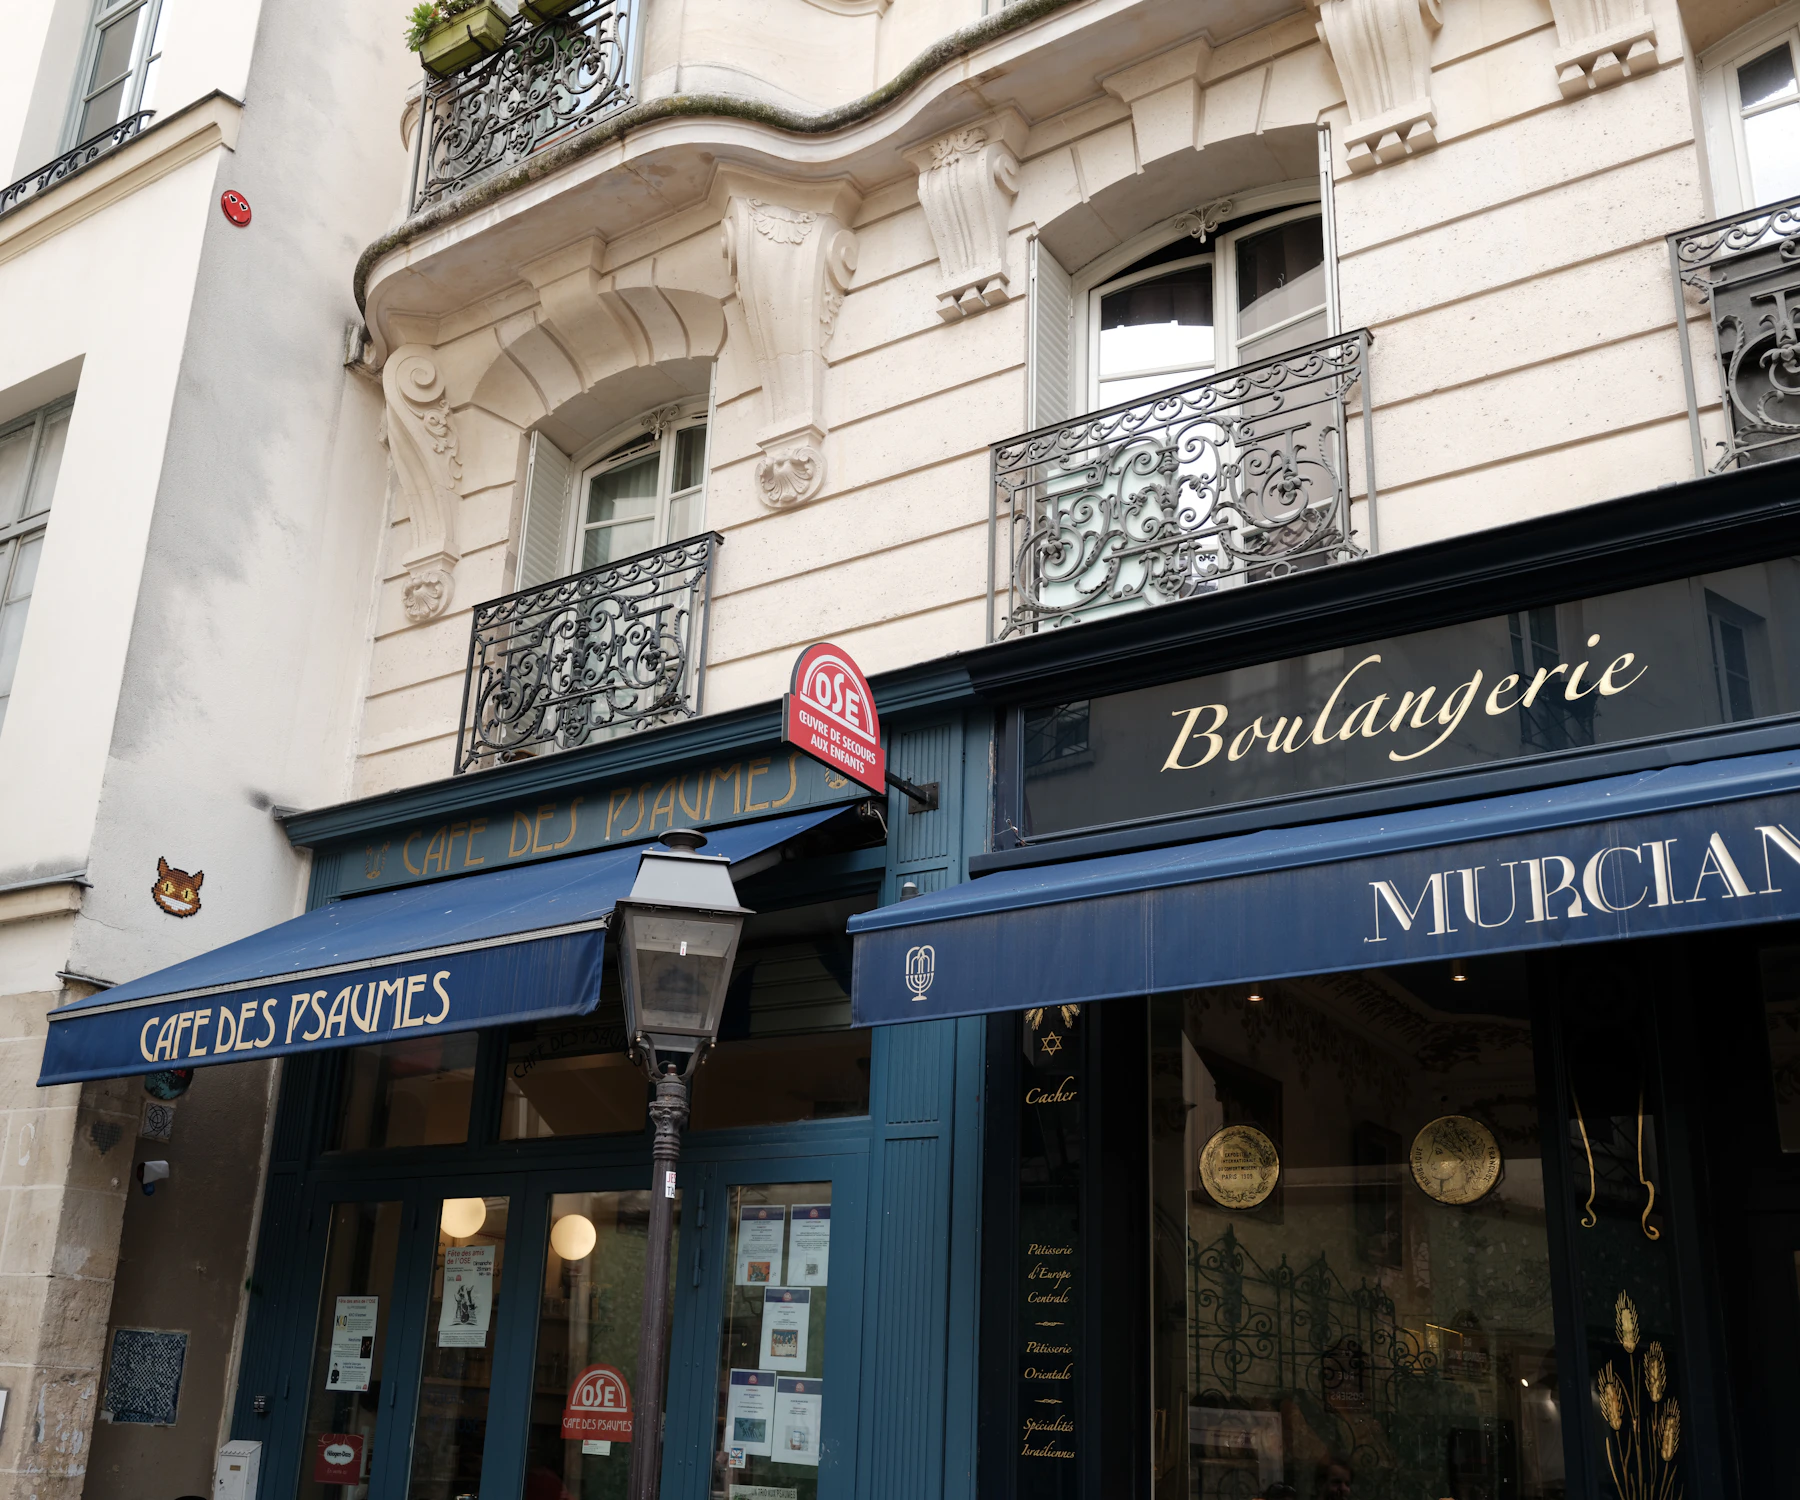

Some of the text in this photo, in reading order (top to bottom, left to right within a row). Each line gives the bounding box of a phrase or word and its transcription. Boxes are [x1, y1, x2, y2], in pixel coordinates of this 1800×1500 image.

[815, 671, 860, 727] OSE
[1160, 633, 1649, 773] Boulangerie
[799, 710, 876, 765] ŒUVRE DE SECOURS
[810, 733, 865, 774] AUX ENFANTS
[402, 750, 803, 877] CAFE DES PSAUMES
[139, 970, 452, 1063] CAFE DES PSAUMES
[1025, 1075, 1078, 1105] Cacher
[447, 1249, 460, 1257] Fête
[472, 1248, 485, 1256] amis
[1027, 1243, 1074, 1255] Pâtisserie
[1027, 1262, 1072, 1290] d'Europe
[1027, 1286, 1072, 1304] Centrale
[1025, 1341, 1073, 1354] Pâtisserie
[1023, 1362, 1074, 1380] Orientale
[581, 1378, 616, 1407] OSE
[562, 1417, 632, 1432] CAFE DES PSAUMES
[1022, 1414, 1074, 1441] Spécialités
[1021, 1440, 1076, 1459] Israéliennes
